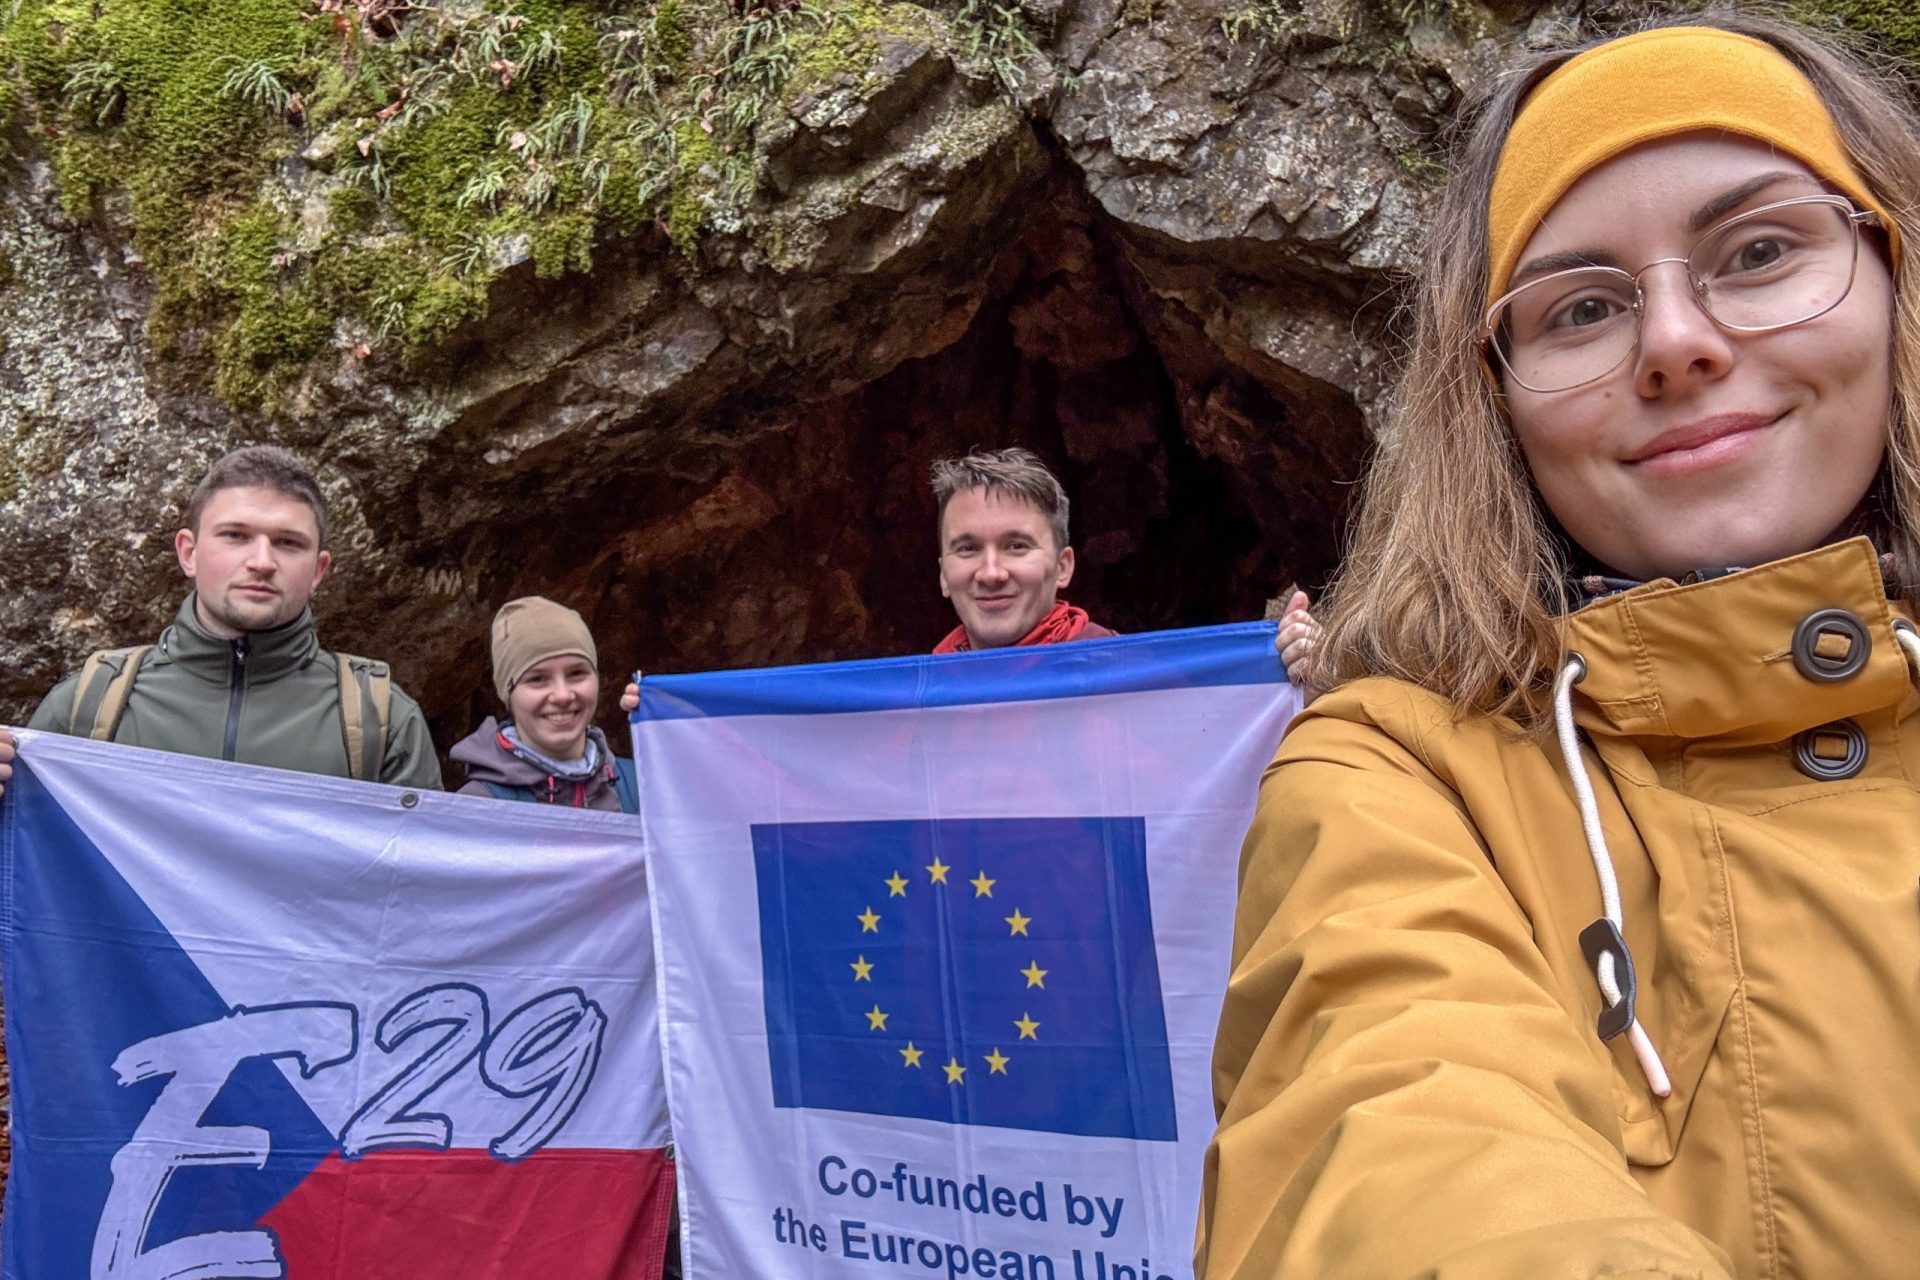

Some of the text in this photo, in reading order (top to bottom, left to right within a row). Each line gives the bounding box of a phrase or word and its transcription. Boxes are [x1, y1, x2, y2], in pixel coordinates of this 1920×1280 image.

[818, 1155, 1125, 1239] Co-funded by
[772, 1207, 828, 1252] the
[840, 1220, 1057, 1280] European
